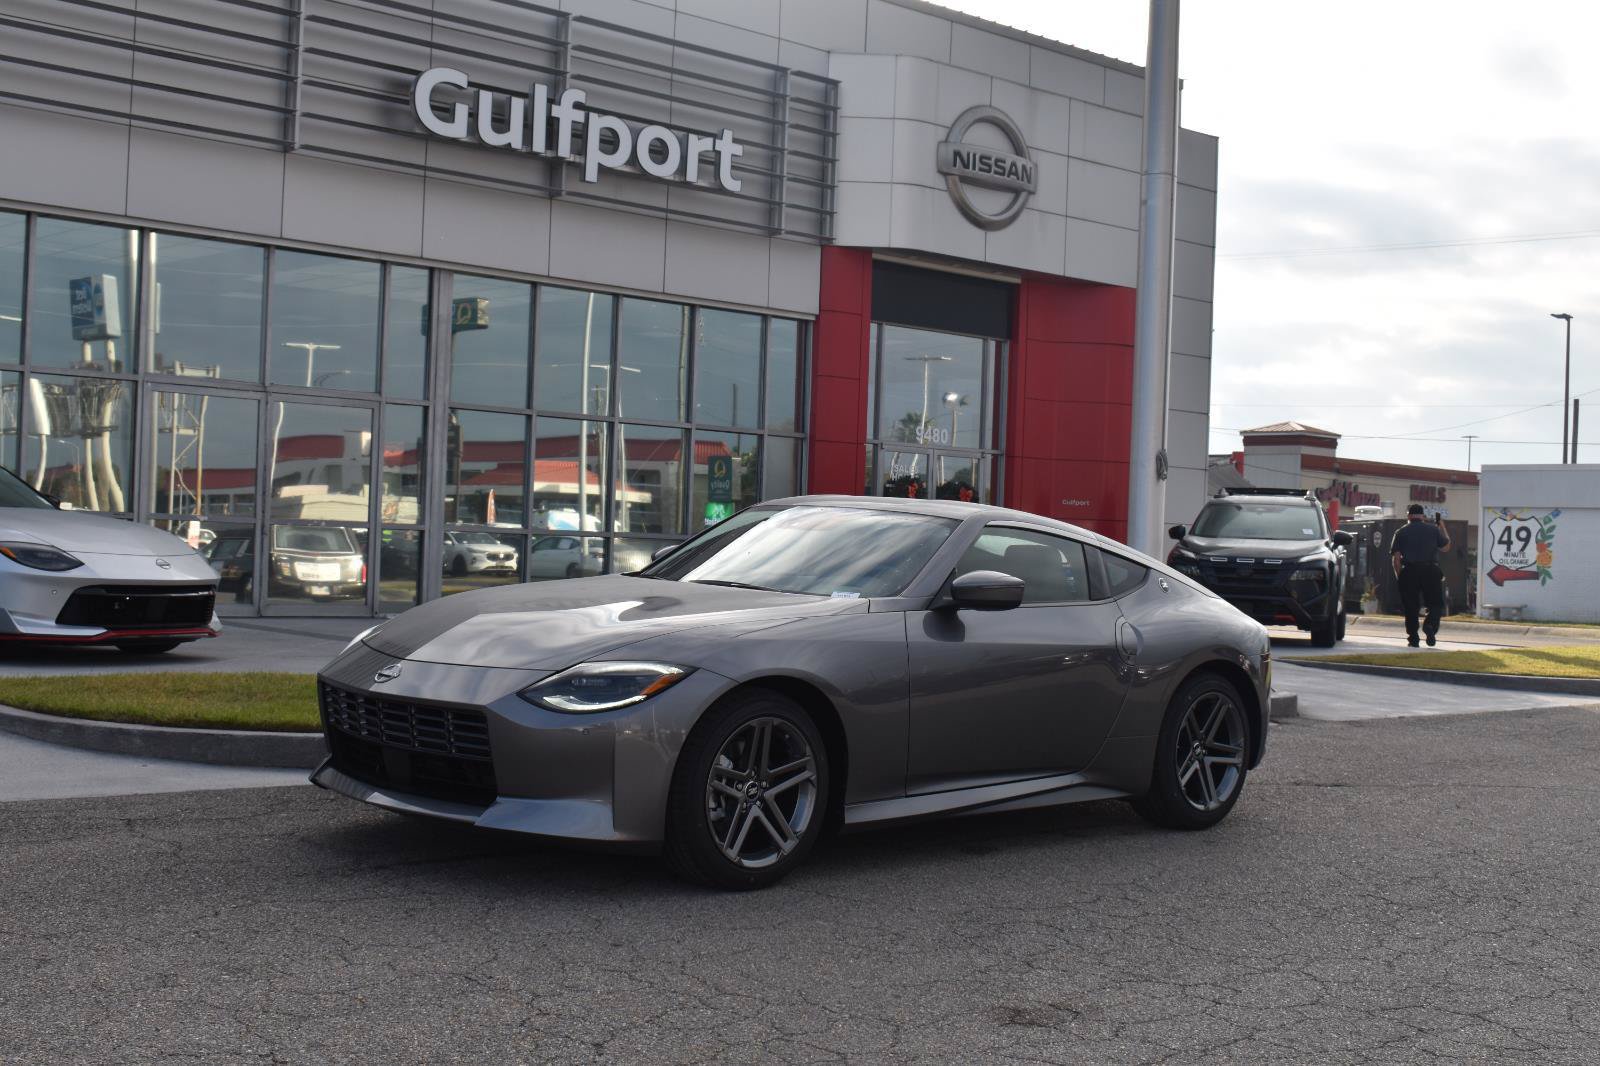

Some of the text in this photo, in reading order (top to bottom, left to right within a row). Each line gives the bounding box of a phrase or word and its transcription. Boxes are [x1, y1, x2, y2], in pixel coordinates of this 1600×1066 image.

[412, 66, 744, 193] Gulfport
[952, 149, 1033, 185] NISSAN
[915, 426, 949, 444] 9480
[1497, 525, 1532, 552] 49
